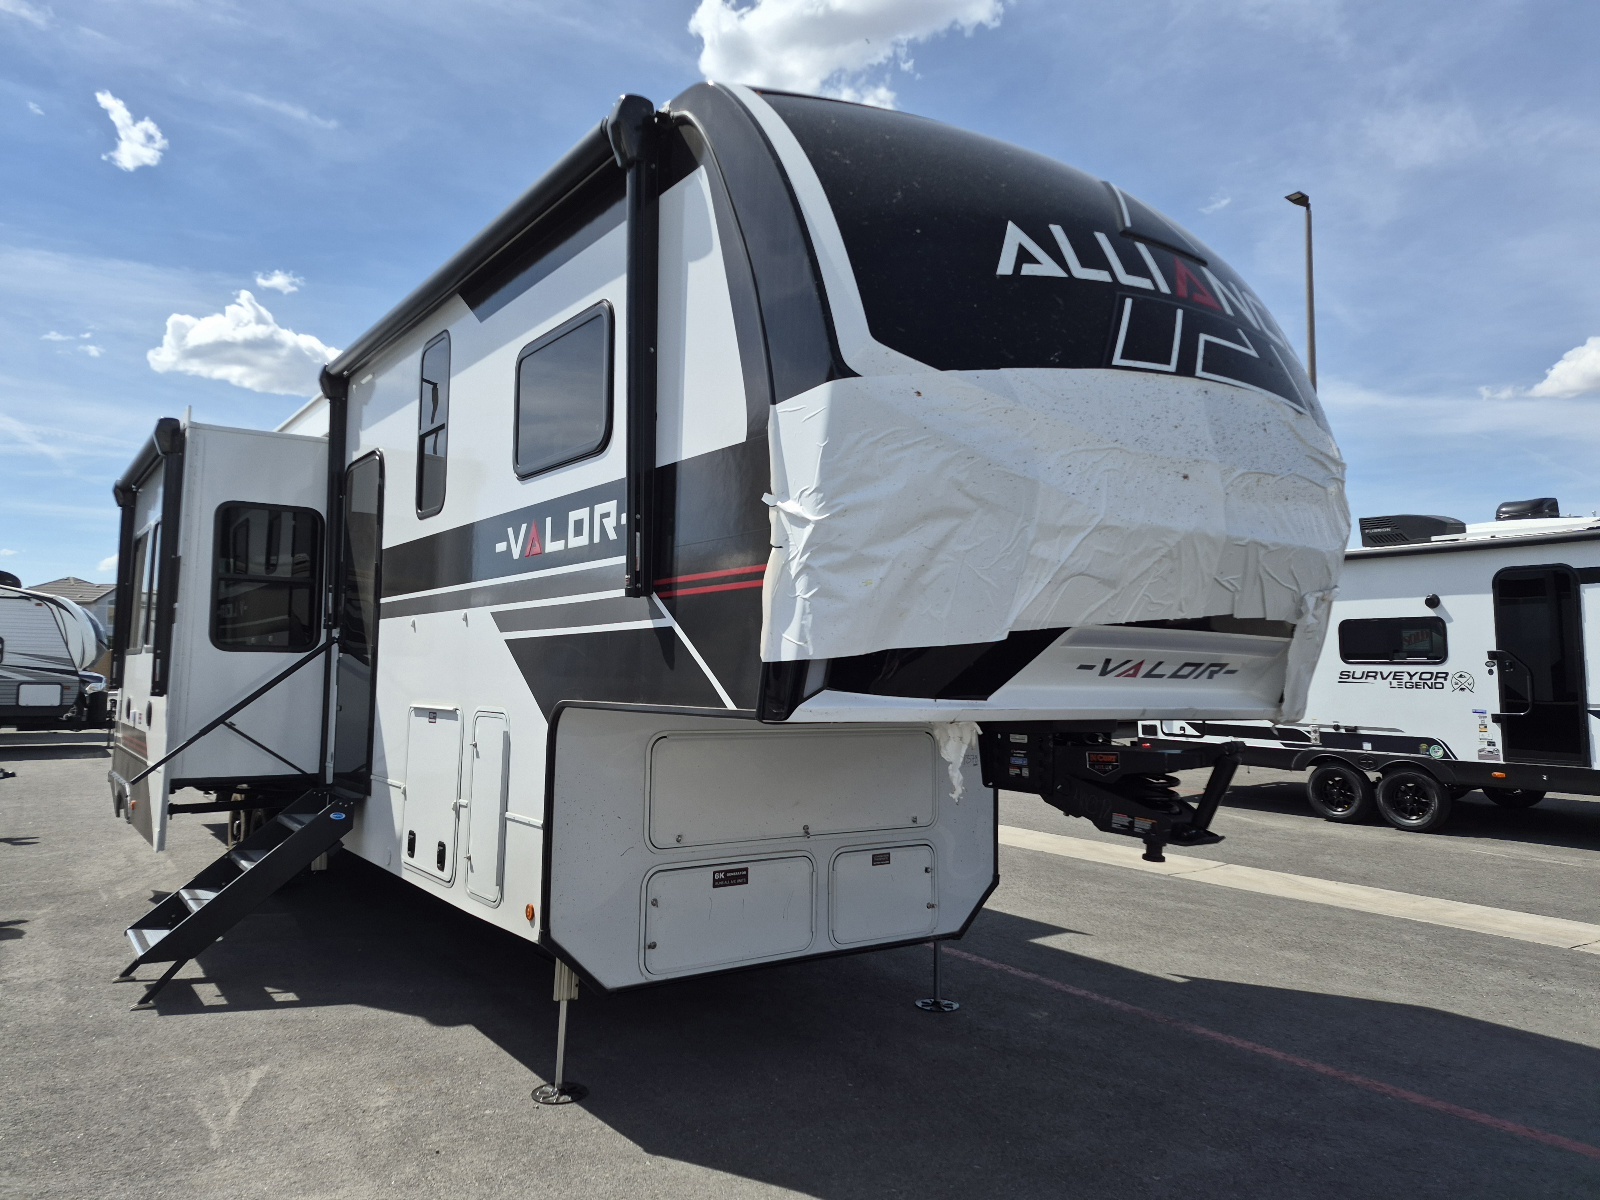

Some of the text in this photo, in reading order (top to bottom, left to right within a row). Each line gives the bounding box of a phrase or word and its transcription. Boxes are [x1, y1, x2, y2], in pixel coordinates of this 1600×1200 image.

[996, 219, 1298, 362] ALLIANC
[1338, 670, 1450, 681] SURVEYOR
[1389, 681, 1445, 690] LEGEND
